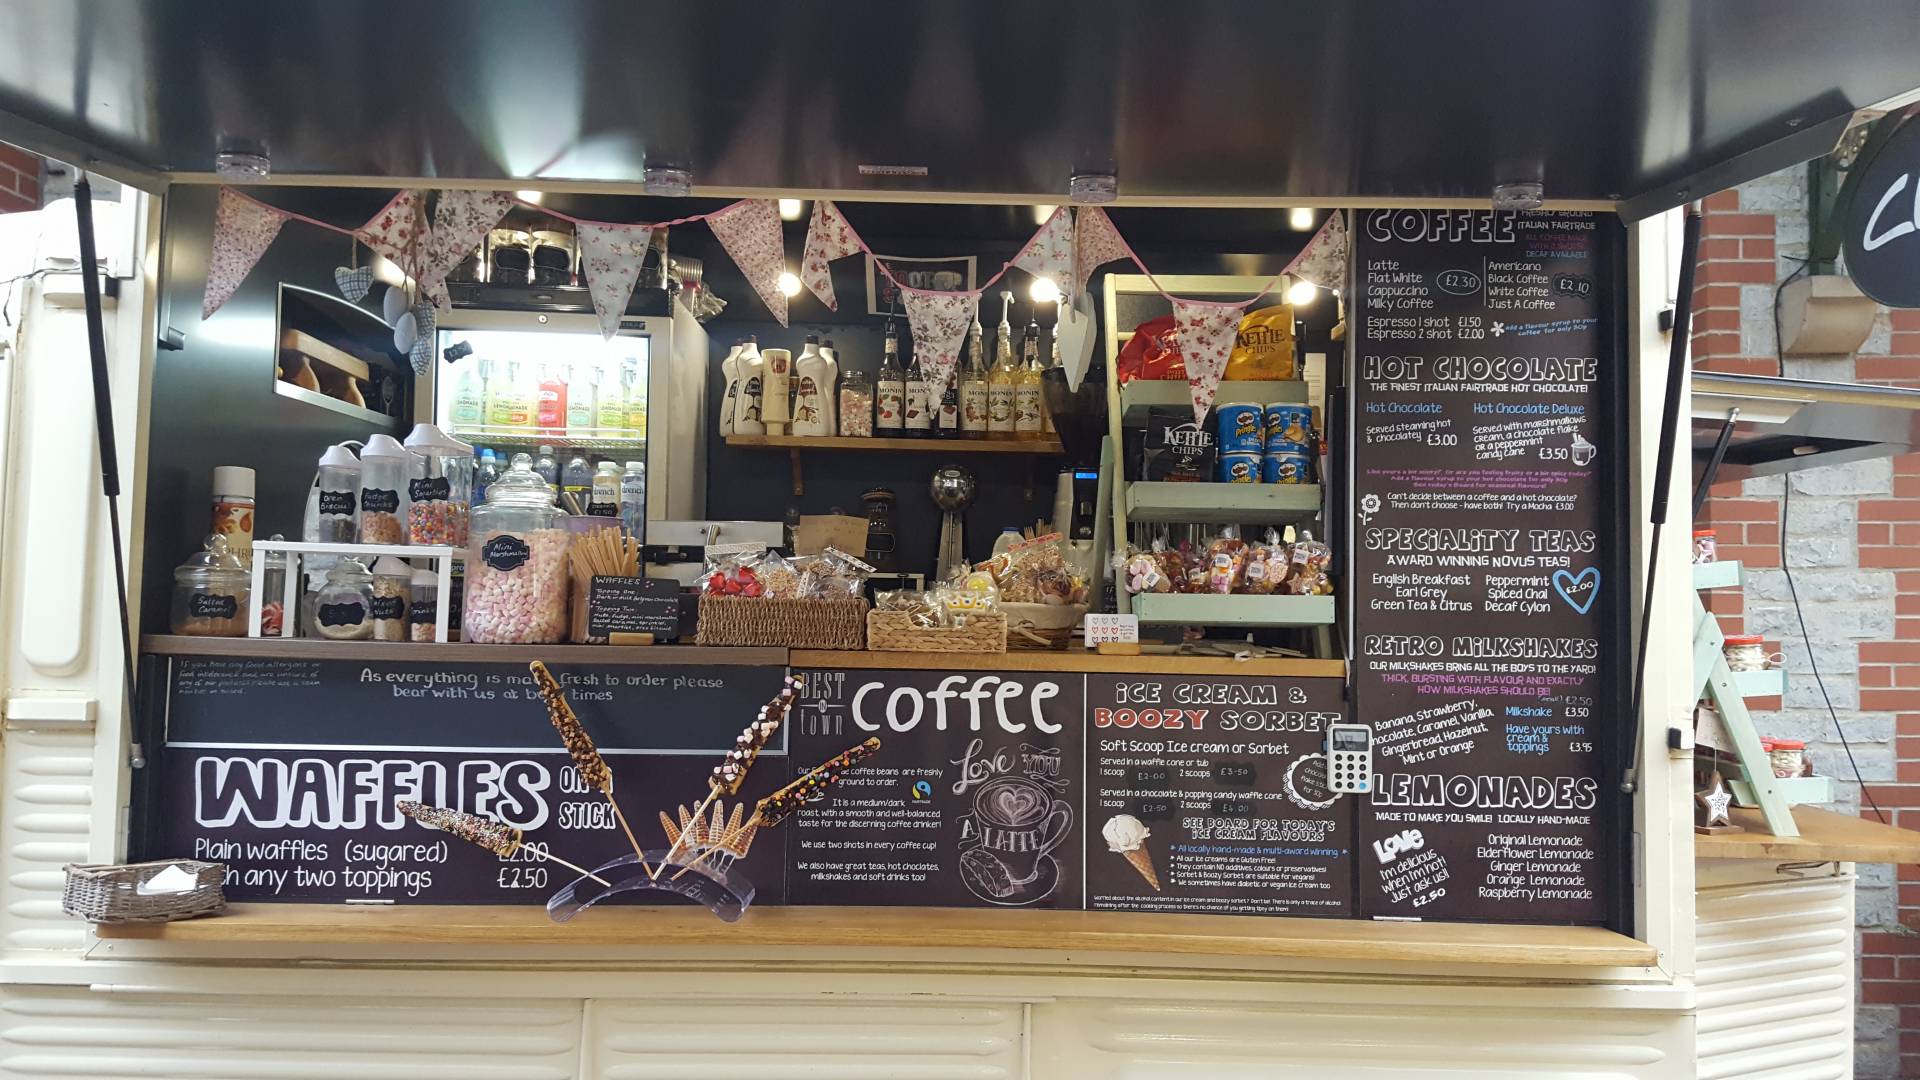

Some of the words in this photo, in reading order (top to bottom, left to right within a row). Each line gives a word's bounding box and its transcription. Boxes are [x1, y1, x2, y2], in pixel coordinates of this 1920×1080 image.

[1367, 209, 1515, 242] COFFEE
[1518, 221, 1549, 229] ITALIAN
[1552, 221, 1596, 230] FAIRTRADE
[1368, 260, 1399, 270] Latte
[1488, 262, 1541, 270] Americano
[1368, 273, 1391, 283] Flat
[1392, 274, 1422, 283] White
[1446, 275, 1476, 288] £2.30
[1488, 274, 1514, 284] Black
[1517, 275, 1548, 284] Coffee
[1368, 286, 1428, 298] Cappuccino
[1488, 287, 1514, 296] White
[1517, 287, 1549, 296] Coffee
[1560, 280, 1589, 293] £2.10
[1367, 298, 1393, 312] Milky
[1397, 299, 1434, 309] Coffee
[1367, 329, 1416, 341] Espresso
[1419, 329, 1424, 339] 2
[1427, 329, 1452, 339] shot
[1458, 329, 1484, 339] £2.00
[1364, 356, 1423, 379] HOT
[1433, 357, 1598, 381] CHOCOLATE
[1371, 383, 1388, 392] THE
[1391, 383, 1421, 392] FINEST
[1424, 384, 1458, 392] ITALIAN
[1461, 384, 1508, 392] FAIRTRADE
[1533, 384, 1588, 393] CHOCOLATE!
[1367, 403, 1386, 412] Hot
[1388, 403, 1442, 413] Chocolate
[1474, 404, 1493, 413] Hot
[1496, 404, 1549, 414] Chocolate
[1552, 404, 1584, 414] Deluxe
[1164, 423, 1213, 447] KETTLE
[1427, 434, 1457, 445] £3.00
[1172, 446, 1203, 455] CHIPS
[1539, 449, 1567, 460] £3.50
[1529, 530, 1596, 553] TEAS
[1387, 555, 1432, 565] AWARD
[1437, 556, 1489, 566] WINNING
[1493, 556, 1534, 567] NOVUS
[1537, 557, 1570, 567] TEAS!
[1373, 574, 1409, 588] English
[1412, 574, 1470, 584] Breakfast
[1486, 575, 1549, 588] Peppermint
[1396, 588, 1418, 597] Earl
[1420, 589, 1447, 600] Grey
[1566, 582, 1593, 594] £2.00
[1488, 589, 1523, 601] Spiced
[1525, 589, 1547, 599] Chai
[1371, 600, 1404, 610] Green
[1408, 600, 1428, 610] Tea
[1431, 601, 1437, 610] &
[1440, 600, 1472, 611] Citrus
[1485, 602, 1517, 611] Decaf
[1520, 602, 1550, 615] Cylon
[1365, 636, 1443, 655] RETRO
[361, 668, 381, 682] As
[386, 670, 478, 691] everything
[486, 675, 500, 683] is
[560, 672, 598, 687] fresh
[605, 674, 620, 685] to
[627, 674, 668, 686] order
[673, 678, 724, 688] please
[801, 673, 845, 699] BEST
[393, 686, 426, 697] bear
[432, 688, 468, 698] with
[475, 690, 495, 699] us
[504, 689, 518, 699] at
[572, 689, 613, 701] times
[1173, 684, 1277, 704] CREAM
[1289, 688, 1307, 704] &
[1506, 707, 1552, 716] Milkshake
[1565, 708, 1589, 717] £3.50
[801, 713, 842, 735] town
[1095, 708, 1208, 729] BOOZY
[1220, 711, 1341, 732] SORBET
[1506, 725, 1529, 734] Have
[1532, 727, 1560, 736] yours
[1563, 726, 1585, 734] with
[1507, 735, 1535, 743] cream
[1538, 734, 1548, 743] &
[1100, 741, 1127, 752] Soft
[1130, 741, 1163, 755] Scoop
[1167, 742, 1187, 752] Ice
[1190, 743, 1229, 753] cream
[1232, 744, 1243, 753] or
[1248, 743, 1289, 755] Sorbet
[1508, 742, 1549, 755] toppings
[1570, 743, 1592, 752] £3.95
[951, 739, 1015, 795] Love
[1022, 754, 1060, 776] YOU
[1372, 774, 1597, 809] LEMONADES
[559, 802, 616, 829] STICK
[1376, 812, 1401, 821] MADE
[1403, 813, 1415, 821] TO
[1418, 814, 1443, 822] MAKE
[1445, 814, 1463, 822] YOU
[1466, 814, 1493, 822] SMILE!
[1498, 815, 1534, 824] LOCALLY
[1537, 816, 1590, 824] HAND-MADE
[1183, 819, 1202, 828] SEE
[1207, 819, 1248, 829] BOARD
[1253, 820, 1277, 829] FOR
[1281, 820, 1335, 831] TODAY'S
[961, 820, 978, 839] A
[983, 828, 1041, 852] LATTE
[1215, 830, 1255, 840] CREAM
[1260, 830, 1324, 842] FLAVOURS
[1489, 834, 1526, 850] Original
[1528, 835, 1582, 845] Lemonade
[196, 838, 242, 860] Plain
[248, 840, 328, 861] waffles
[344, 840, 448, 870] (sugared)
[1477, 847, 1537, 859] Elderflower
[1539, 849, 1594, 859] Lemonade
[1491, 862, 1525, 877] Ginger
[1527, 863, 1582, 872] Lemonade
[244, 870, 288, 894] any
[294, 866, 336, 886] two
[342, 866, 432, 896] toppings
[497, 868, 547, 889] £2.50
[1487, 874, 1525, 890] Orange
[1530, 875, 1585, 885] Lemonade
[1413, 888, 1446, 907] £2.50
[1479, 888, 1536, 901] Raspberry
[1538, 889, 1592, 899] Lemonade
